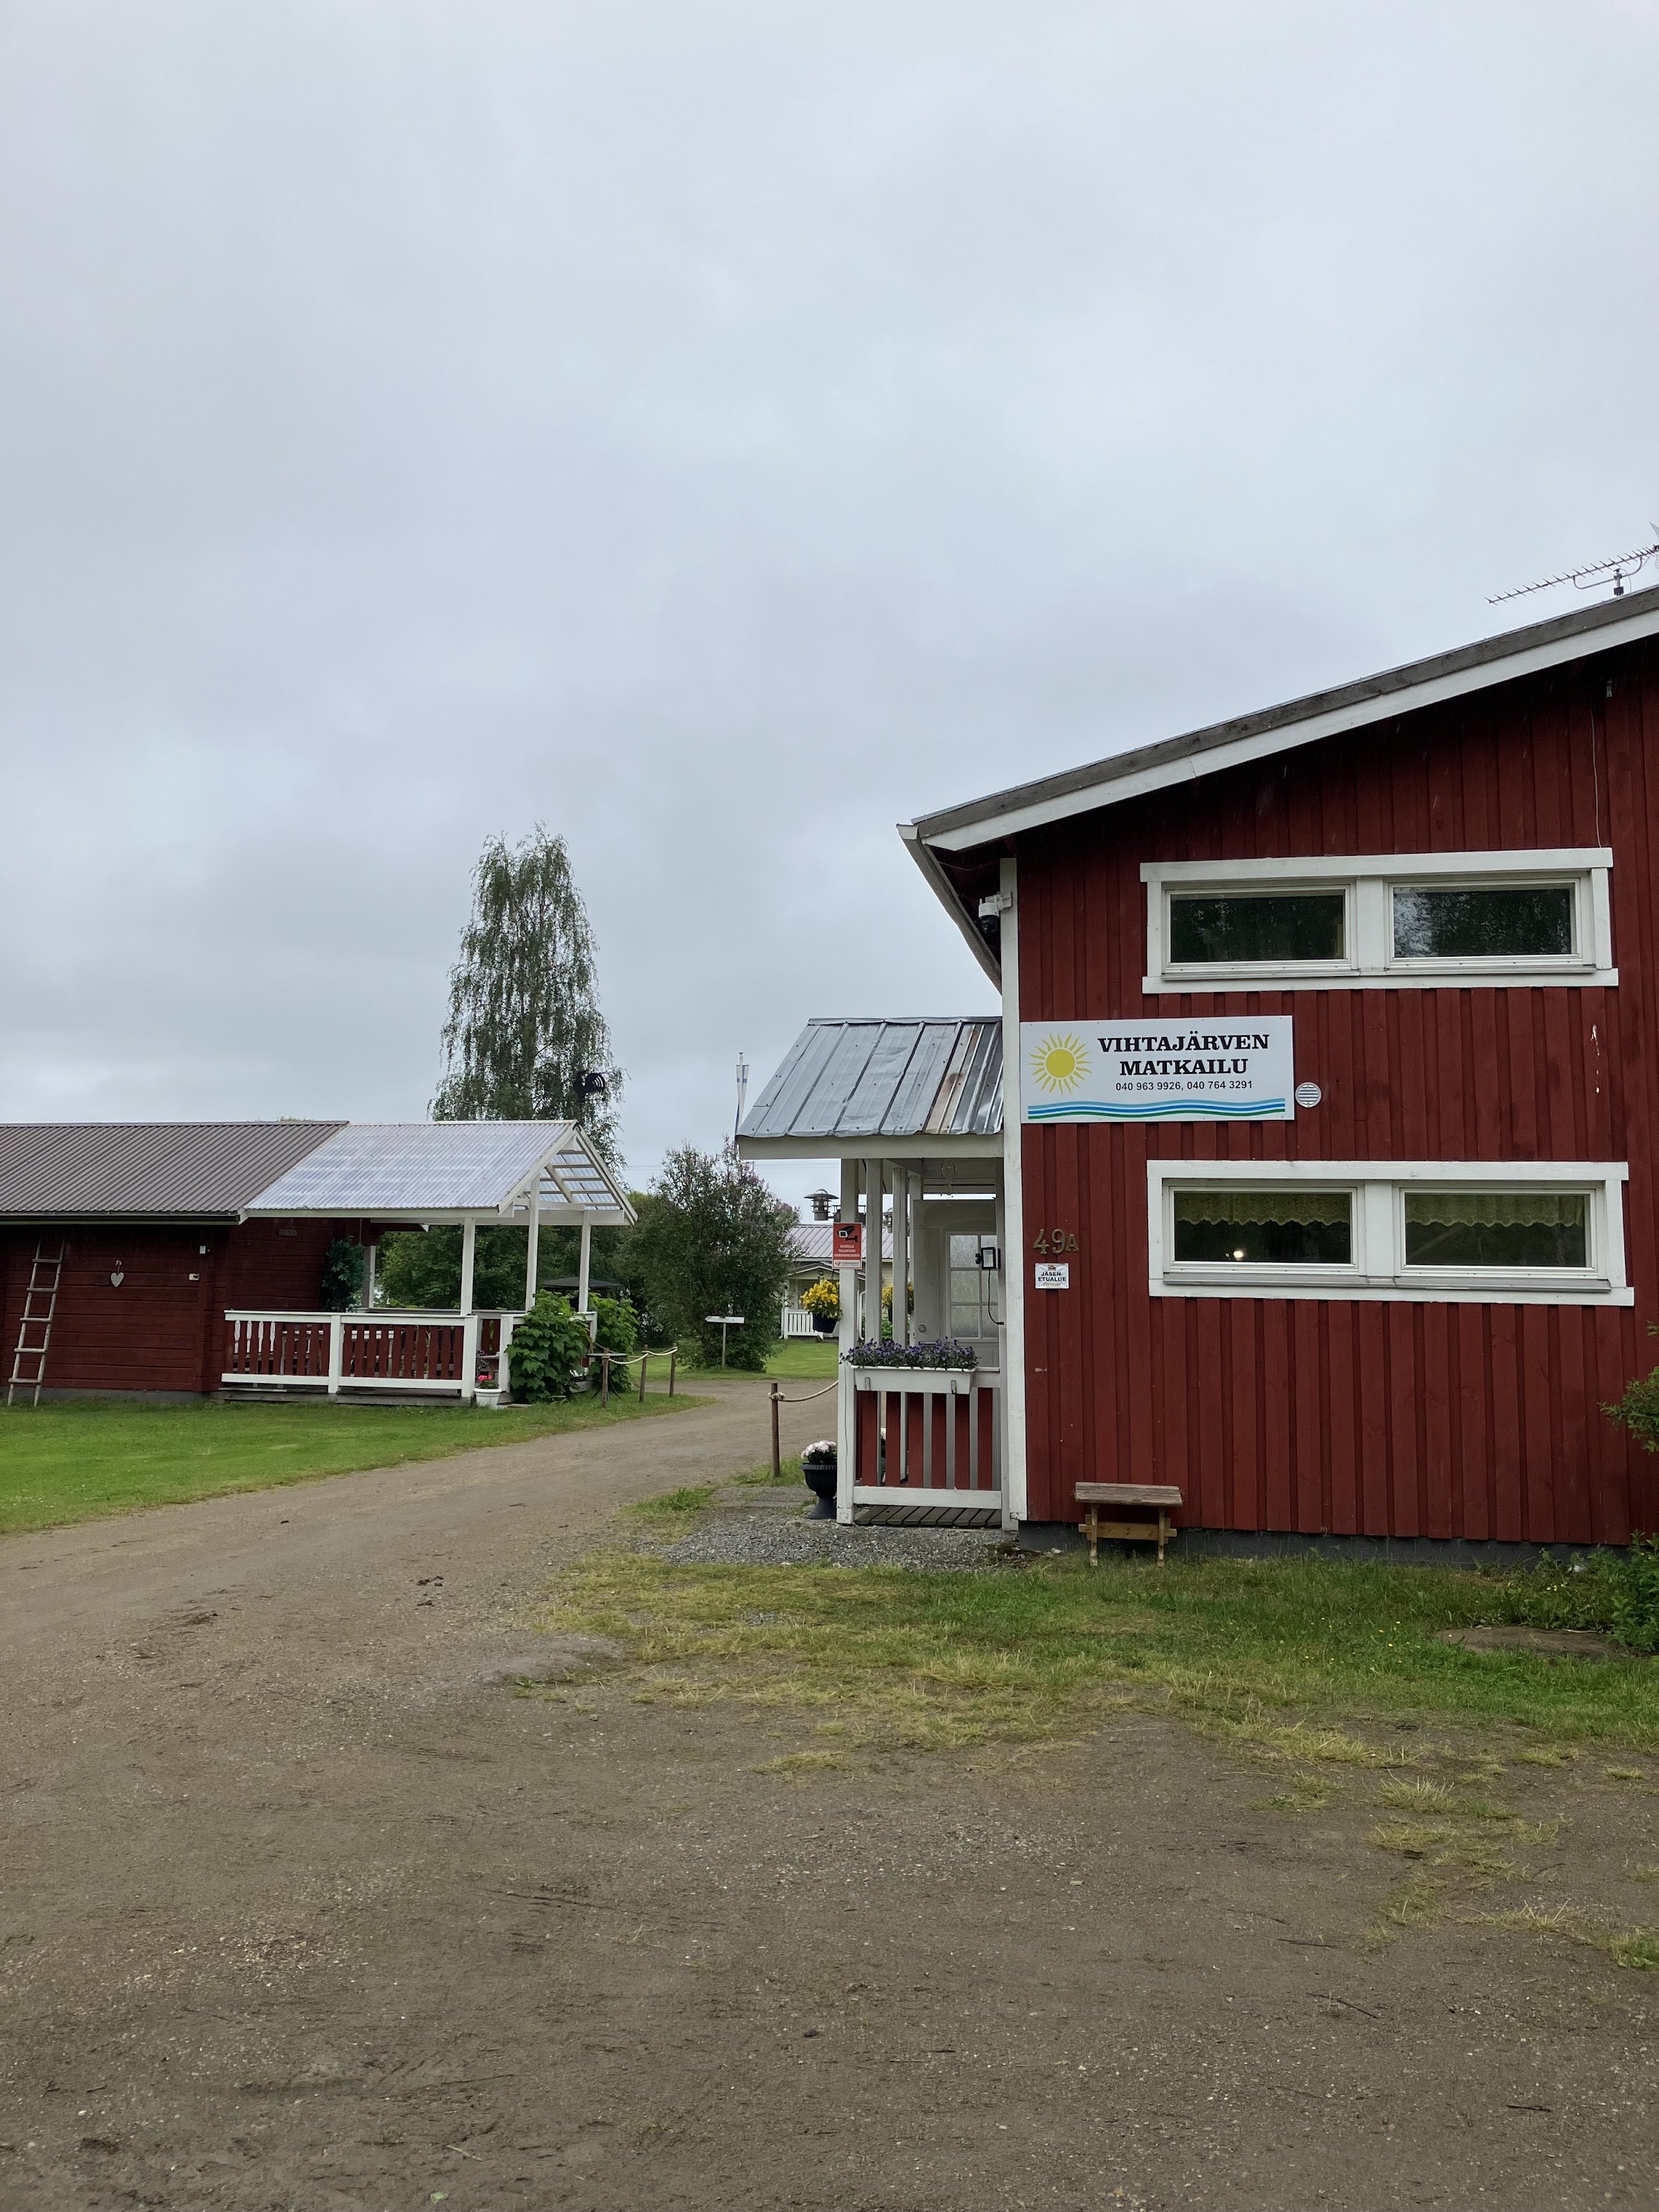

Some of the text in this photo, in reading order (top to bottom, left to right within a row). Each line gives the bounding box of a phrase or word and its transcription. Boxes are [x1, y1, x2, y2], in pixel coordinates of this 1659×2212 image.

[1097, 1031, 1270, 1052] VIHTAJÄRVEN
[1119, 1058, 1248, 1076] MATKAILU
[1136, 1082, 1154, 1090] 963
[1157, 1081, 1183, 1091] 9926,
[1187, 1081, 1204, 1089] 040
[1208, 1080, 1226, 1089] 764
[1229, 1080, 1252, 1089] 3291
